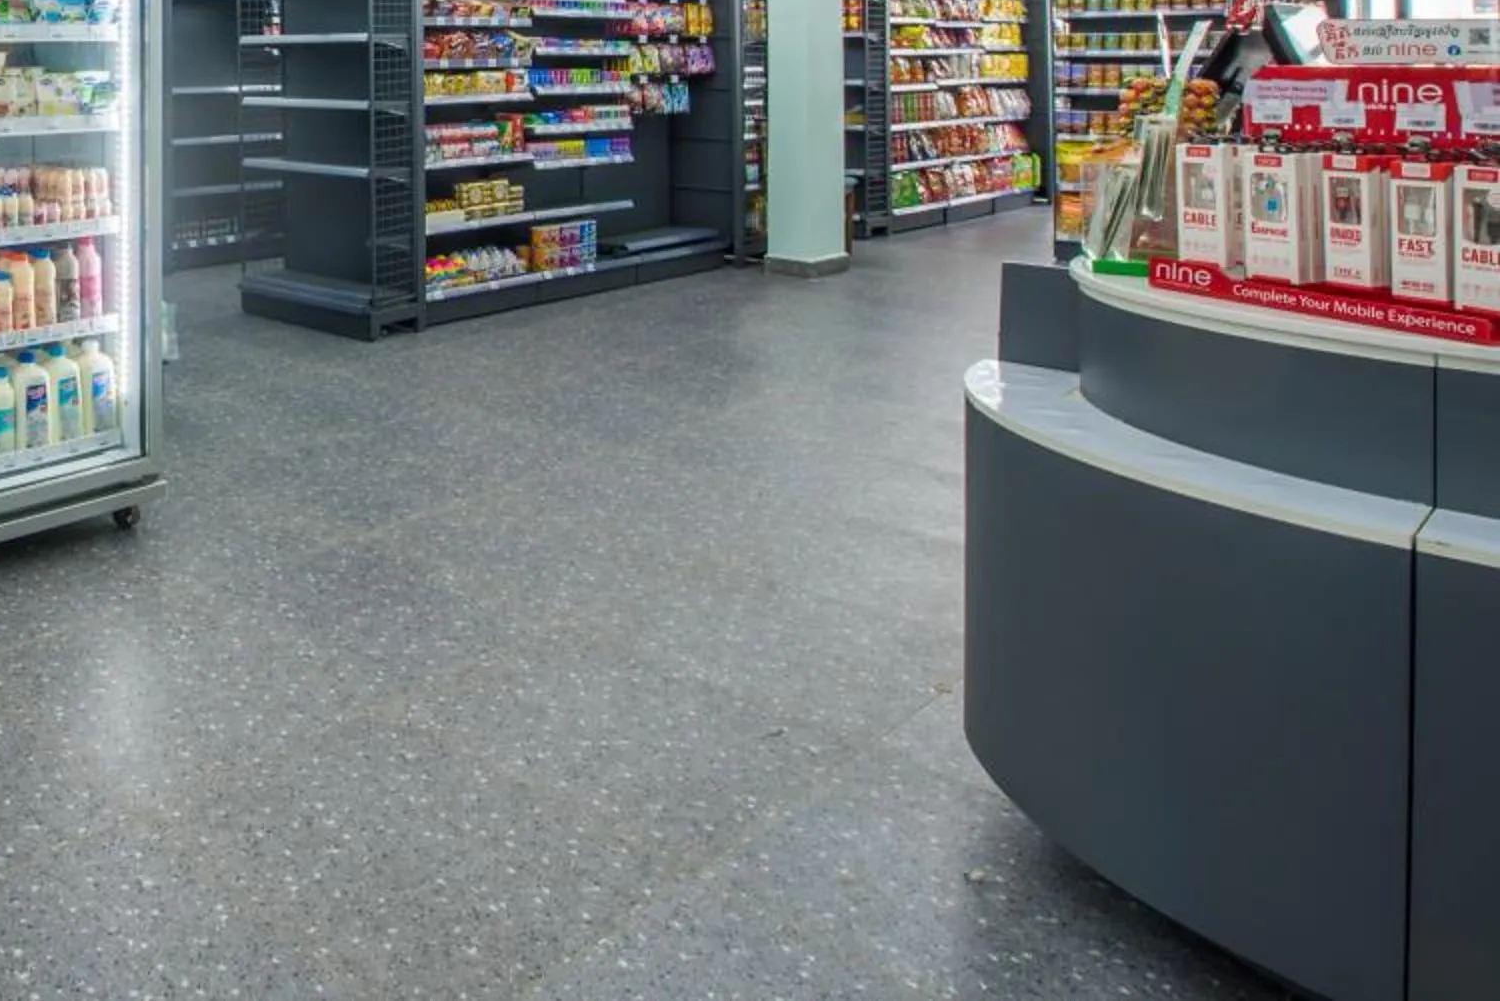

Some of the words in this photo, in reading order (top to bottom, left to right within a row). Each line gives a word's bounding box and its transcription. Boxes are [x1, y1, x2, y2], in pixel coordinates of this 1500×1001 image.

[1387, 41, 1438, 56] nine
[1357, 79, 1444, 104] nine
[1155, 261, 1212, 286] nine
[1233, 284, 1297, 307] Complete
[1299, 293, 1330, 311] Your
[1333, 300, 1384, 322] Mobile
[1387, 309, 1477, 337] Experience
